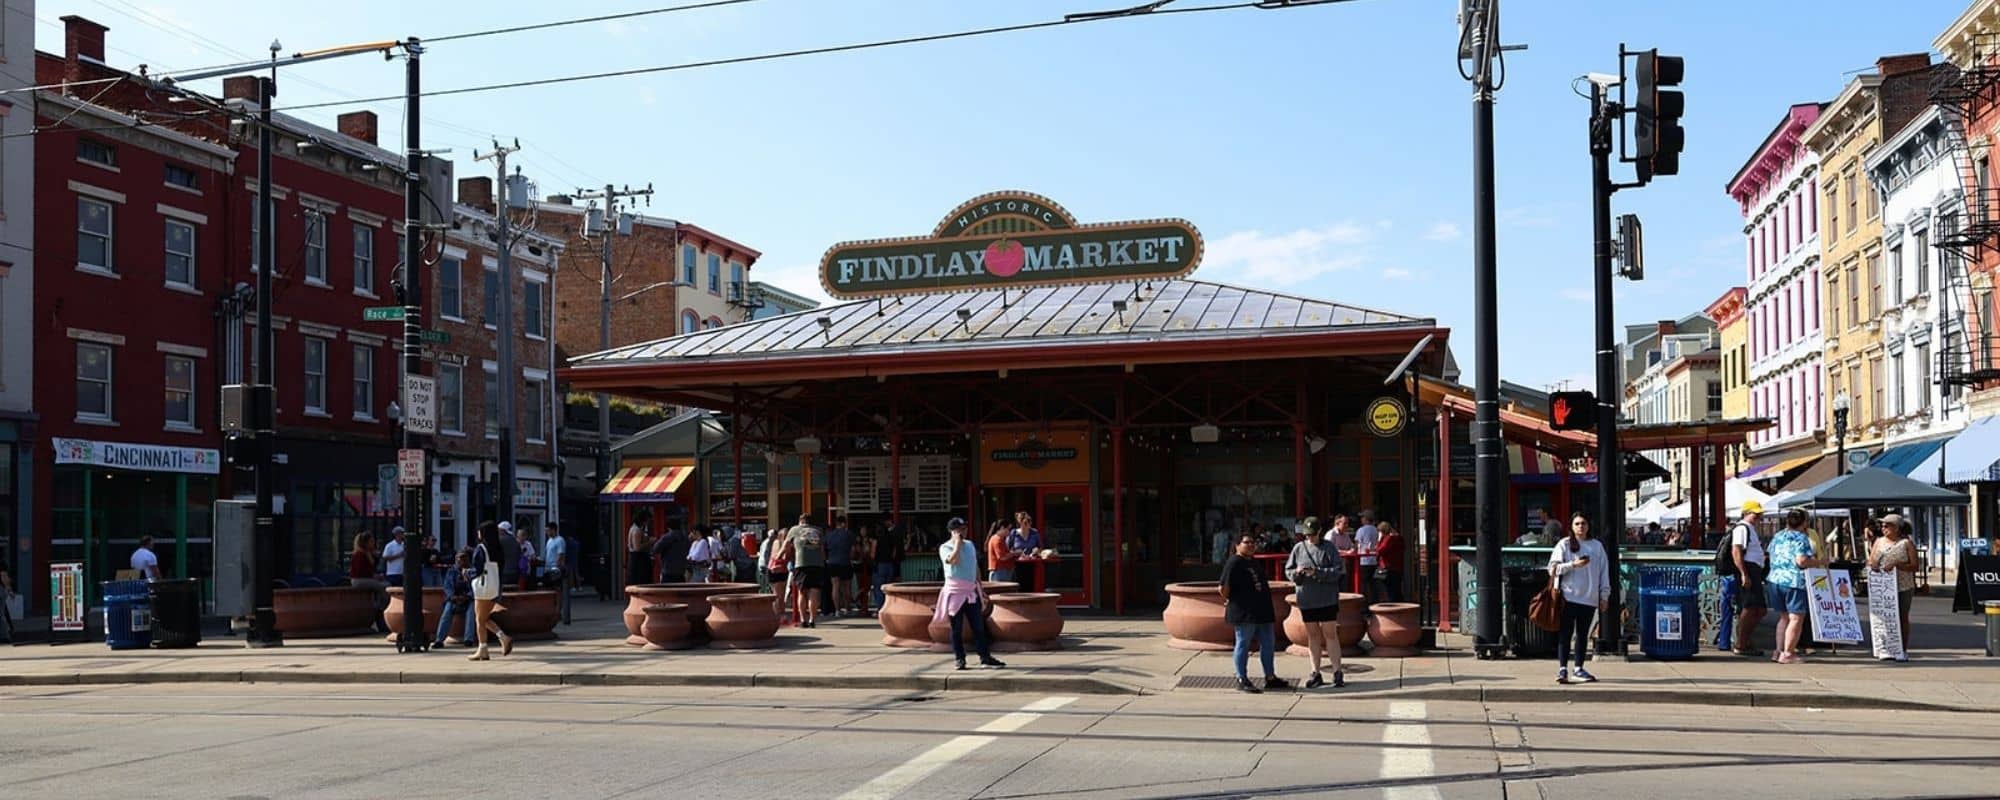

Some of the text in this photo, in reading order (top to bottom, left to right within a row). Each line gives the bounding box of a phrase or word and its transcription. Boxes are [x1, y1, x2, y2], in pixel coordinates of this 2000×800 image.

[957, 200, 1053, 228] HISTORIC
[838, 236, 1184, 285] FINDLAY MARKET
[366, 310, 387, 319] Race
[409, 380, 432, 392] DO NOT
[412, 393, 429, 404] STOP
[416, 406, 425, 416] ON
[409, 417, 433, 429] TRACKS
[103, 444, 183, 468] CINCINNATI
[993, 448, 1075, 460] FINDLAY MARKET
